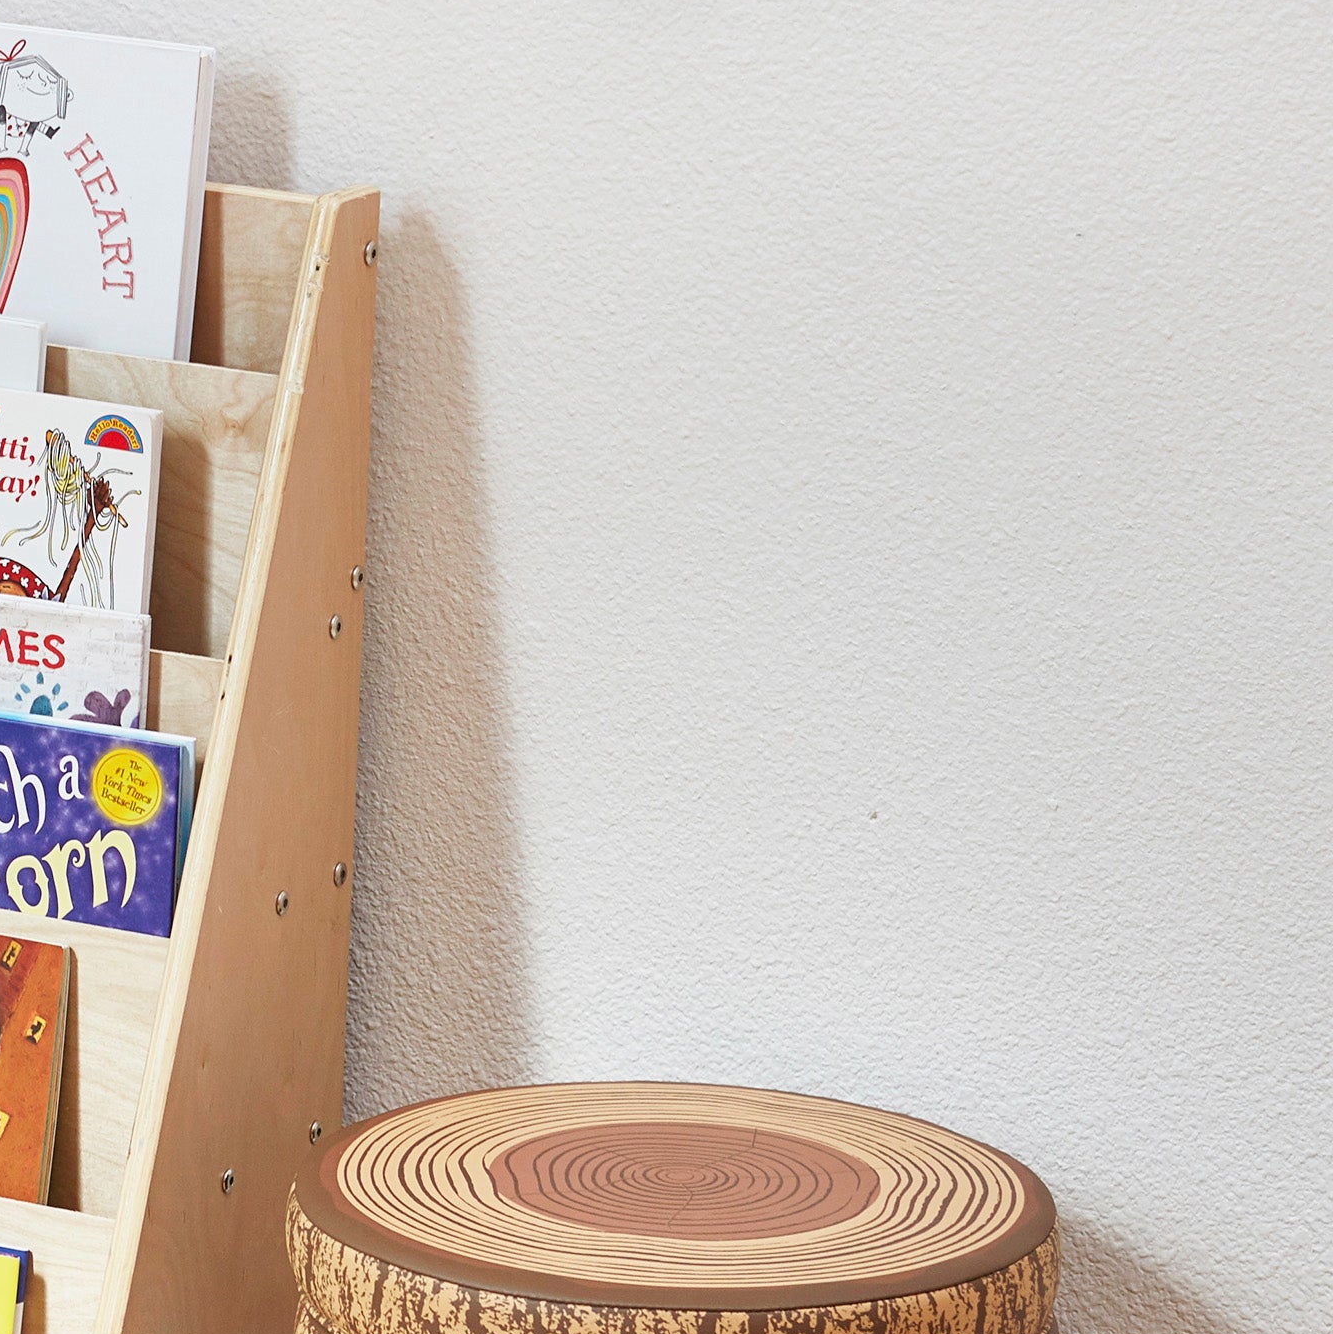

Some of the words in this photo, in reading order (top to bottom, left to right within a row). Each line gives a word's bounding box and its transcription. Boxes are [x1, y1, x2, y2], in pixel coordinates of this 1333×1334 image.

[63, 132, 136, 301] HEART
[90, 420, 111, 443] Hello
[58, 754, 85, 802] a
[127, 772, 148, 787] New
[129, 759, 142, 772] The
[101, 787, 146, 815] Bestseller
[103, 774, 125, 793] York
[126, 784, 152, 805] Times
